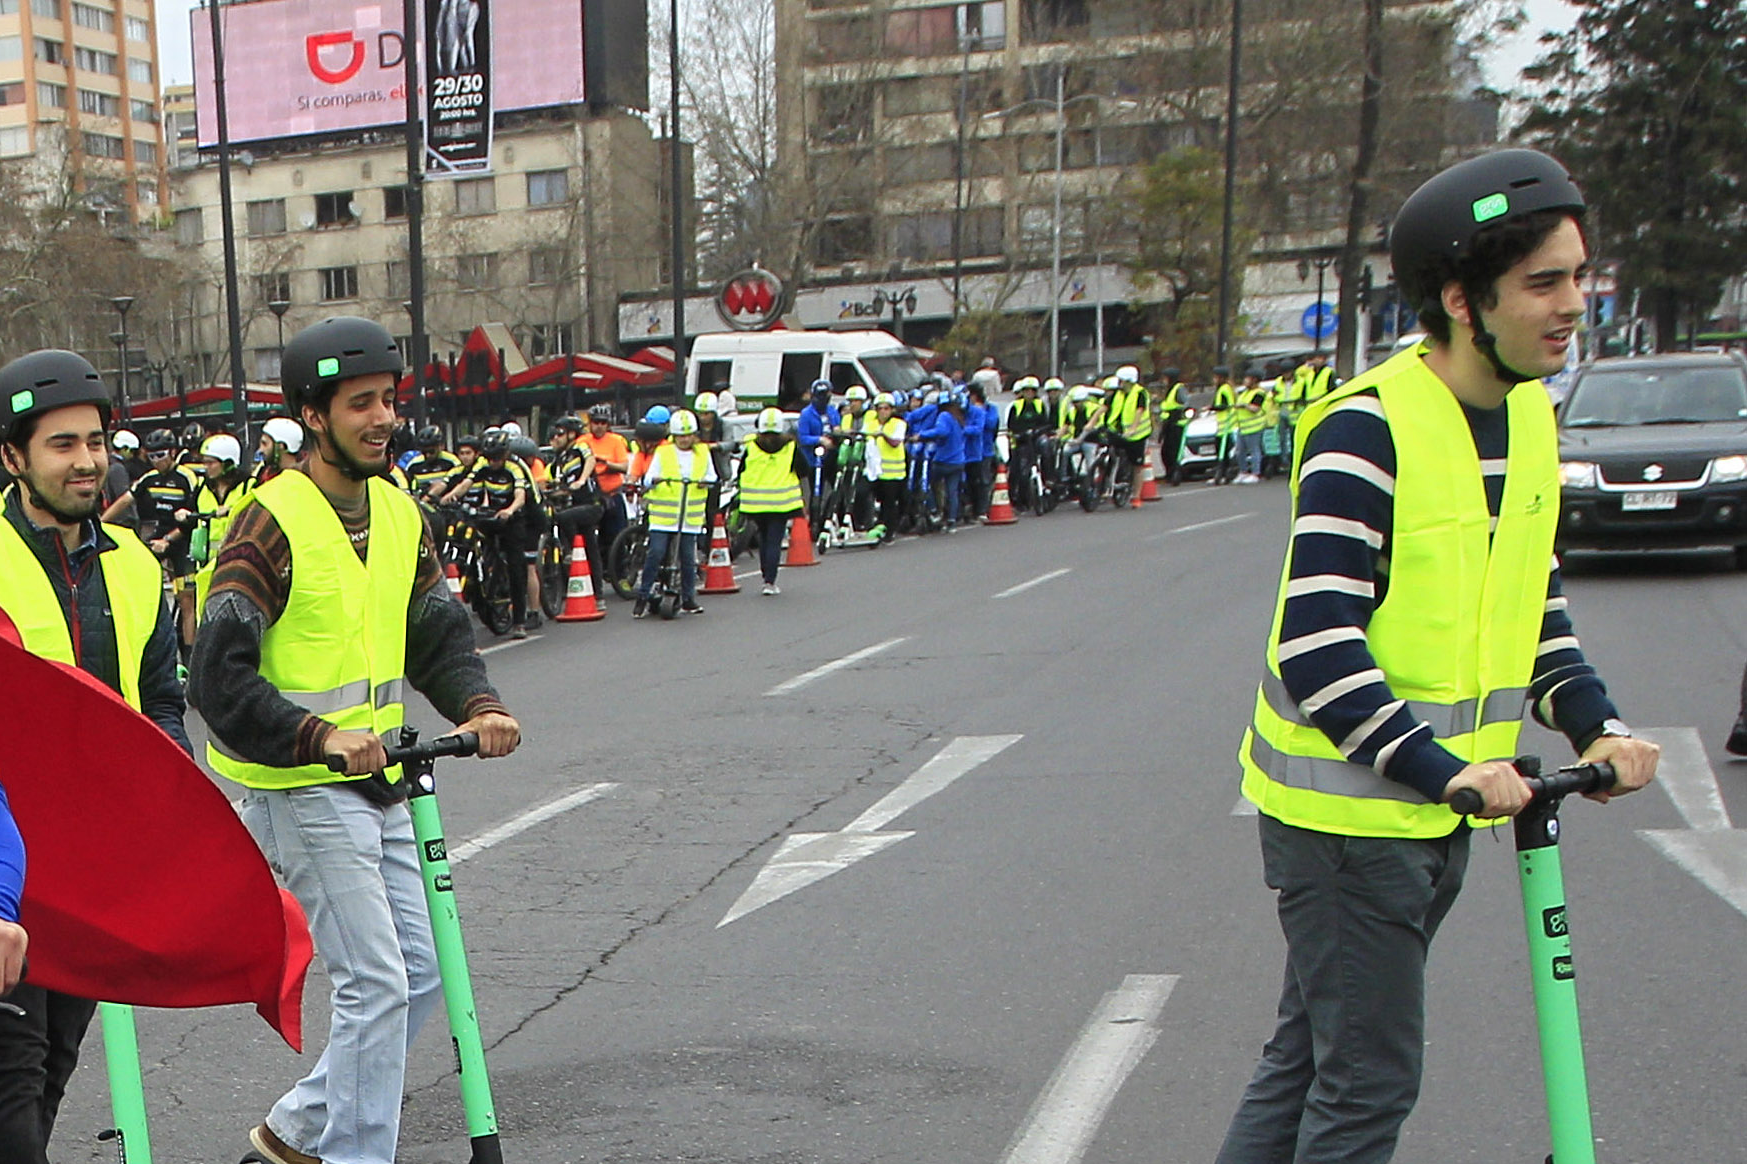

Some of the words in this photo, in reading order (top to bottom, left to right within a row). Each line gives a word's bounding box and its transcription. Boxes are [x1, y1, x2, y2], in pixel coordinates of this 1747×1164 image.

[434, 74, 483, 96] 29/30
[297, 96, 310, 110] Si
[313, 89, 386, 108] comparas,
[433, 93, 483, 110] AGOSTO
